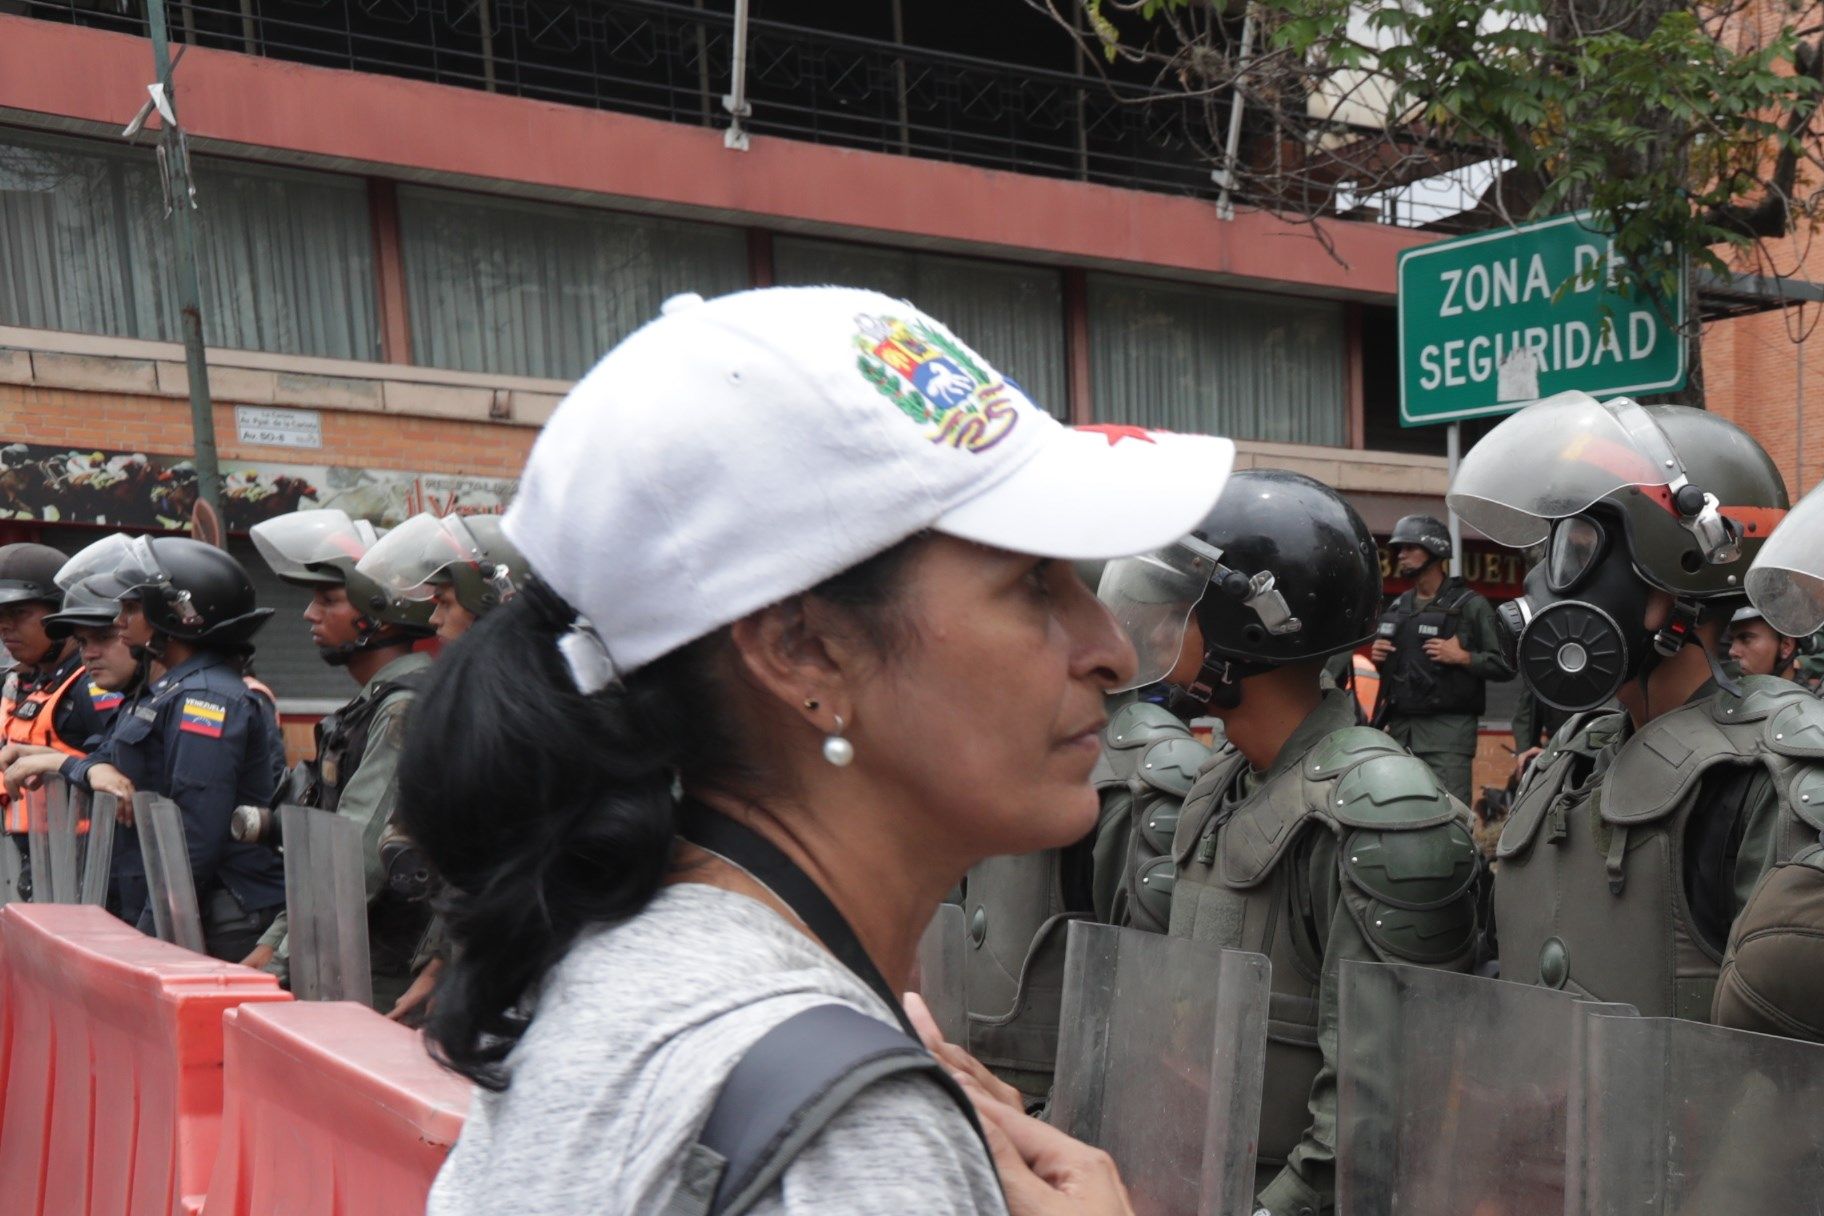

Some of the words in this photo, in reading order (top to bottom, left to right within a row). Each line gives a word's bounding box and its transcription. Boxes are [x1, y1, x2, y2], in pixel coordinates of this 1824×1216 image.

[1440, 254, 1551, 317] ZONA
[1420, 311, 1657, 390] SEGURIDAD
[185, 697, 226, 713] VENEZUELA
